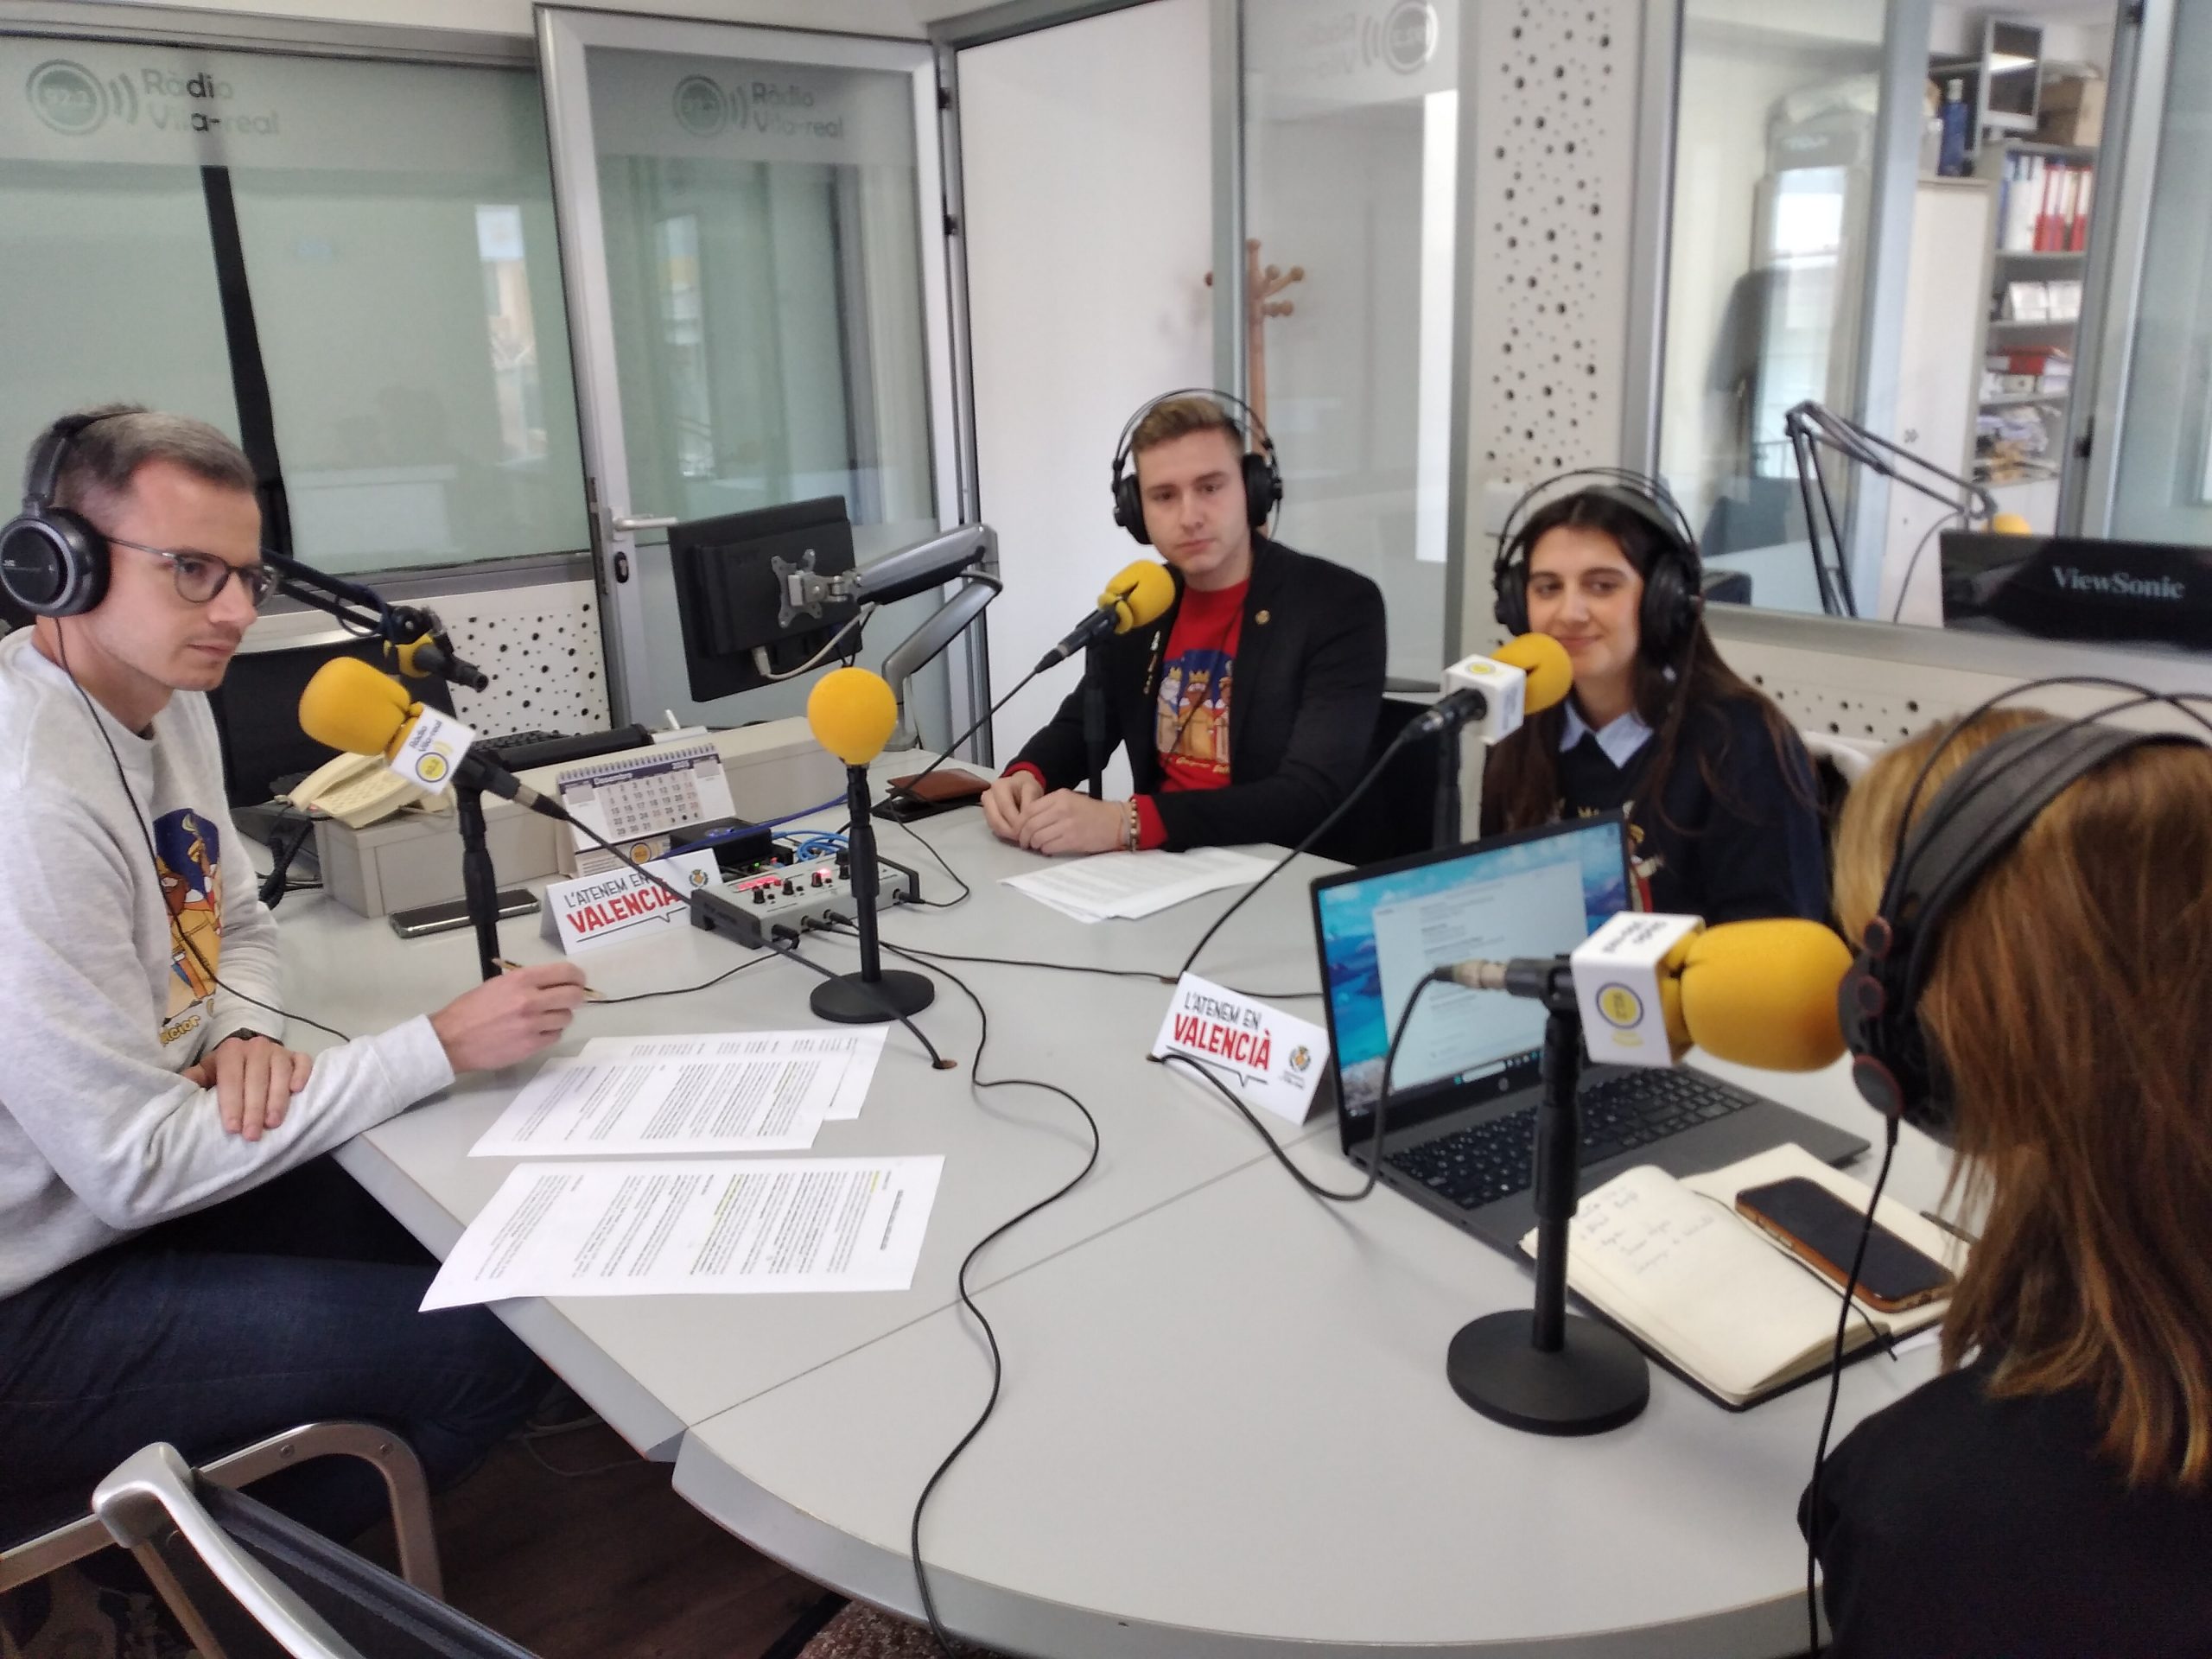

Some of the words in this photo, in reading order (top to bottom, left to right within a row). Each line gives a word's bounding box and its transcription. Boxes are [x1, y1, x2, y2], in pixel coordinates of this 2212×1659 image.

[2052, 566, 2185, 599] ViewSonic
[564, 878, 628, 907] L'ATENEM
[1184, 991, 1240, 1023] L'ATENEM
[1243, 1008, 1262, 1030] EN
[1174, 1013, 1271, 1071] VALENCIÀ
